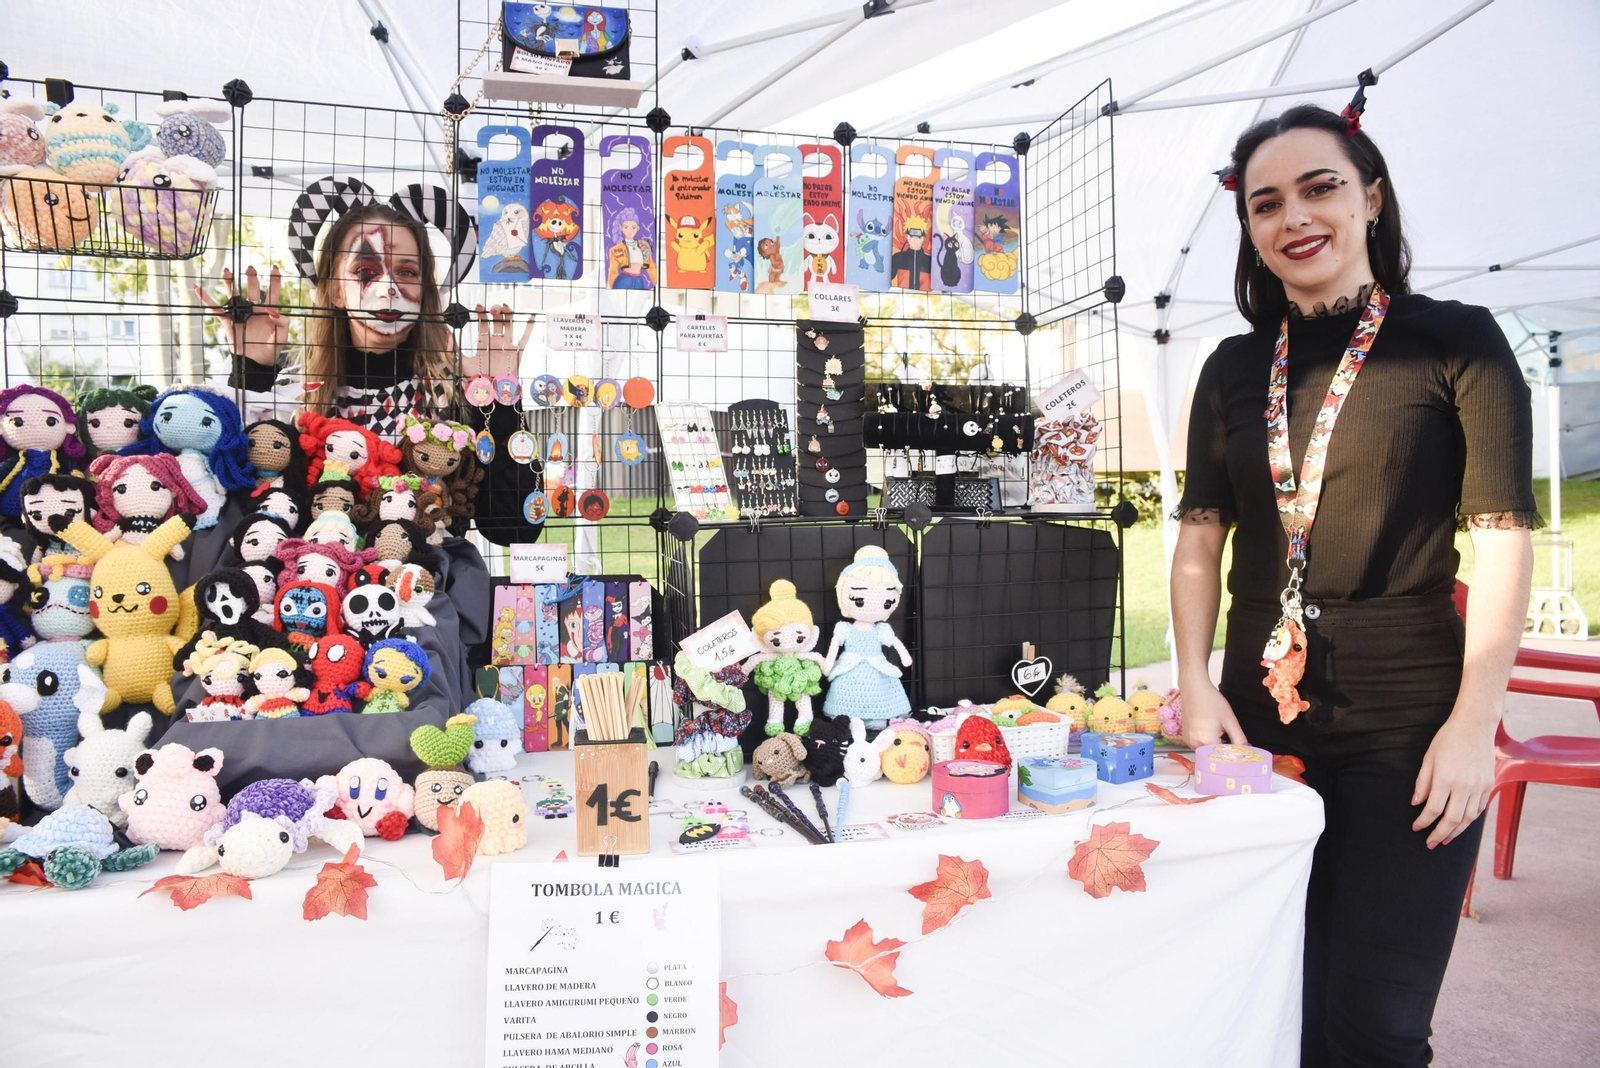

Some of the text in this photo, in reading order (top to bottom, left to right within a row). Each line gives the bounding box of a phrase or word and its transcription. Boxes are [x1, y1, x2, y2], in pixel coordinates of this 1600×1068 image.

[516, 50, 571, 65] BOLSO PINTADO
[522, 57, 543, 65] MANO
[480, 167, 531, 176] NO MOLESTAR
[551, 167, 564, 176] NO
[489, 176, 513, 184] ESTOY
[535, 176, 580, 187] MOLESTAR
[487, 184, 525, 193] HOGWARTS
[603, 184, 652, 193] MOLESTAR
[812, 183, 833, 191] PASAR
[868, 185, 878, 193] NO
[914, 181, 934, 190] PASAR
[717, 188, 754, 198] MOLEST
[755, 190, 802, 199] MOLESTAR
[809, 191, 829, 199] ESTOY
[907, 187, 928, 195] ESTOY
[951, 186, 971, 195] PASAR
[994, 186, 1005, 197] NO
[851, 190, 894, 203] MOLESTAR
[896, 192, 919, 200] VIENDO
[979, 196, 1015, 208] MOLESTAR
[814, 293, 852, 302] COLLARES
[553, 317, 585, 325] LLAVEROS
[1045, 379, 1087, 411] COLETEROS
[1065, 400, 1077, 410] 2€
[697, 628, 738, 655] COLETEROS
[586, 783, 642, 826] 1€
[531, 882, 682, 897] TOMBOLA MAGICA
[595, 910, 620, 924] 1 €
[505, 966, 568, 975] MARCAPAGINA
[504, 982, 597, 992] LLAVERO DE MADERA
[504, 995, 639, 1008] LLAVERO AMIGURUMI PEQUEÑO
[503, 1016, 536, 1024] VARITA
[503, 1029, 638, 1041] PULSERA DE ABALORIO SIMPLE
[662, 1028, 696, 1036] MARRON
[503, 1046, 614, 1057] LLAVERO HAMA MEDIANO
